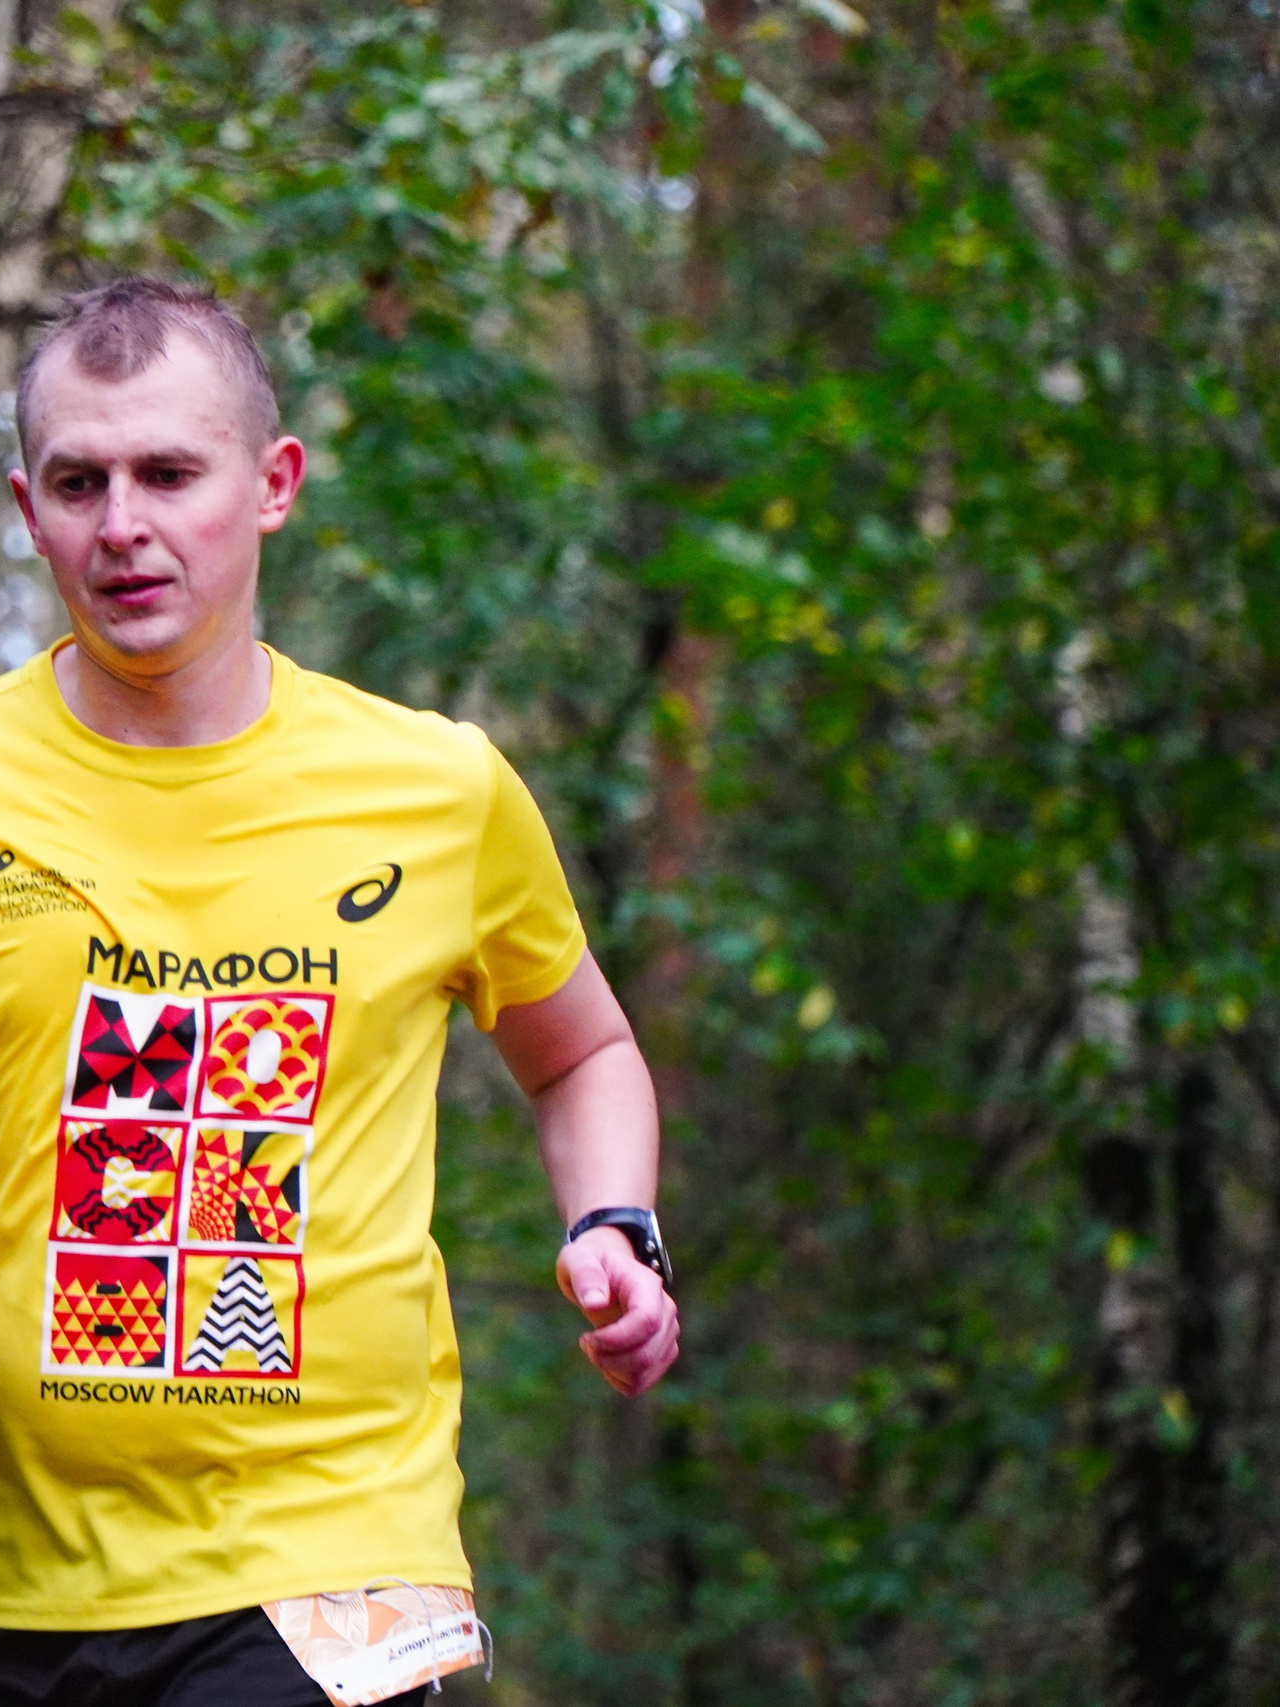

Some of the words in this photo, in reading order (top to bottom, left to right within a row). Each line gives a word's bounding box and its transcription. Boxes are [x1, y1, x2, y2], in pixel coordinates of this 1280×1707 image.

[0, 901, 88, 923] MARATHON
[86, 935, 339, 991] МАРАФОН
[40, 1380, 155, 1403] MOSCOW
[163, 1384, 301, 1405] MARATHON
